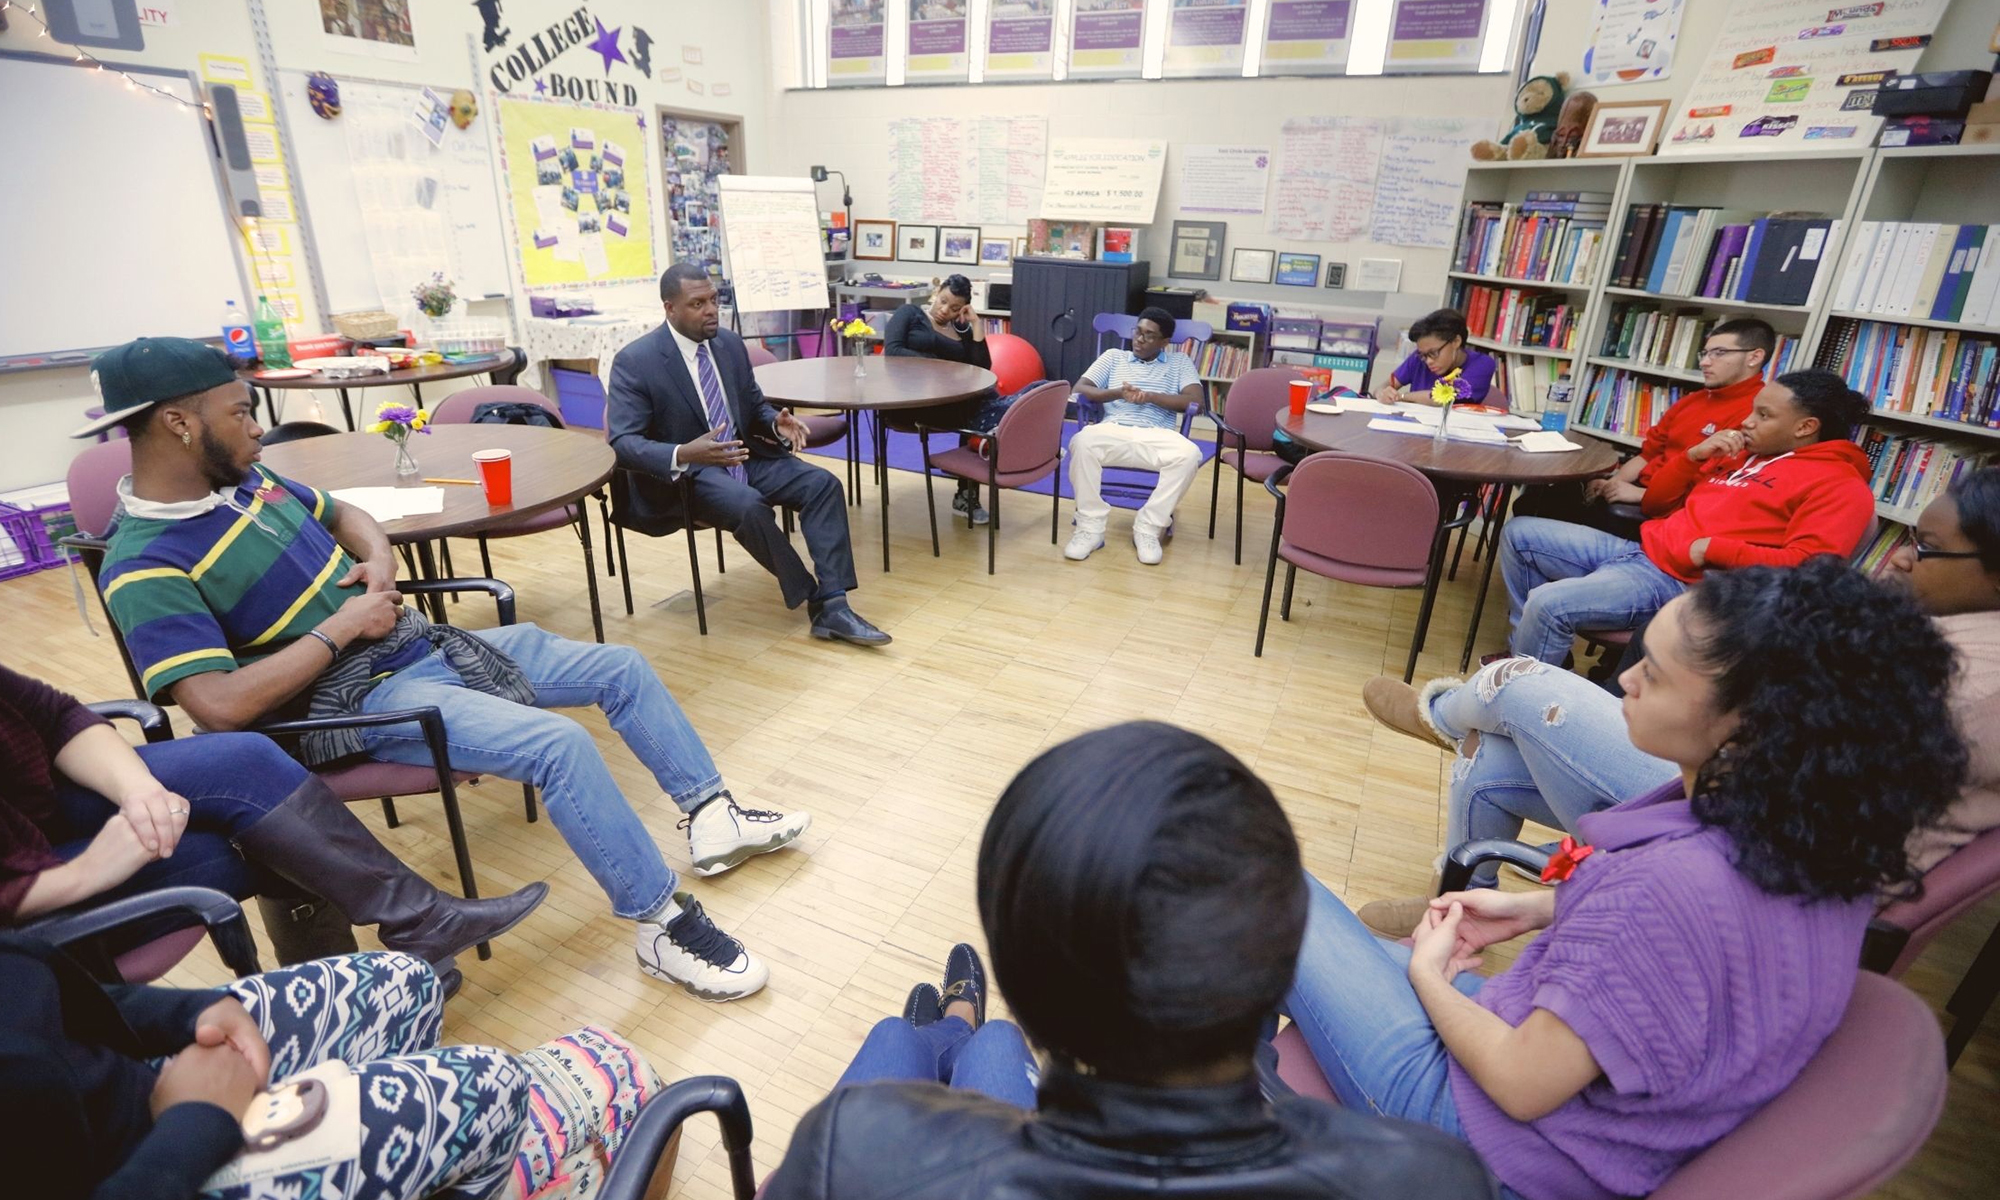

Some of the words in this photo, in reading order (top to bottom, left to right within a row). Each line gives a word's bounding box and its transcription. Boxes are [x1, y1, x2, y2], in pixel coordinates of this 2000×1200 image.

[491, 6, 596, 93] COLLEGE
[1890, 36, 1920, 46] SKOR
[550, 73, 638, 107] BOUND
[1076, 189, 1101, 197] AFRICA
